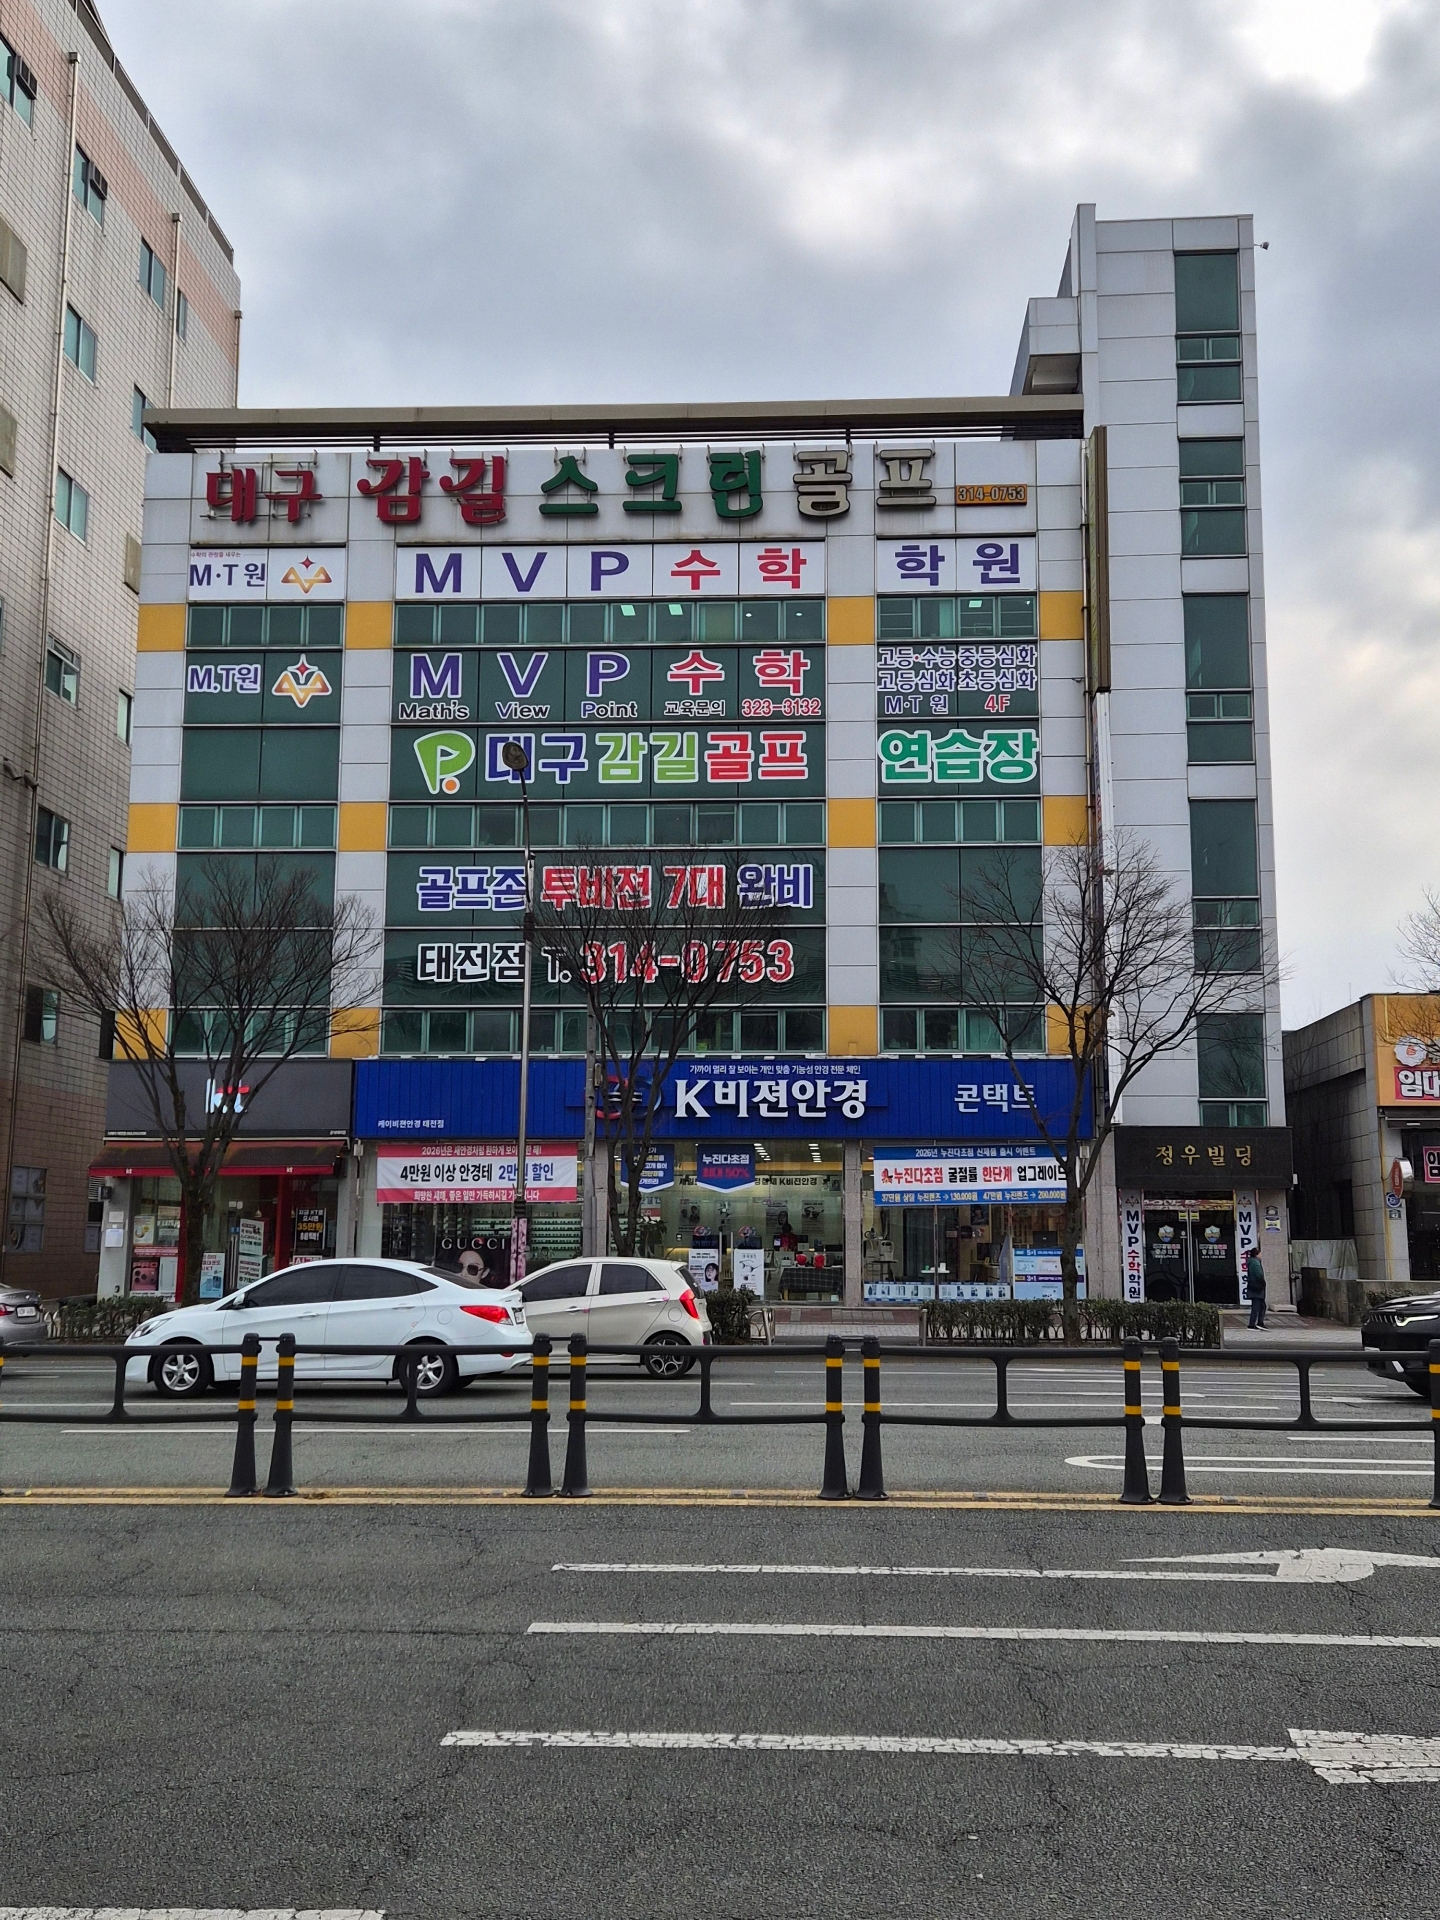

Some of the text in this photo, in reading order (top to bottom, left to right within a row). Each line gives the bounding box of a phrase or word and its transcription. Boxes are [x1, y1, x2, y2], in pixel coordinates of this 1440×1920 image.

[206, 448, 937, 525] 대구 감길 스크린 골프
[957, 486, 1026, 501] 314-0753
[958, 645, 1037, 668] 중등심화
[877, 668, 1037, 692] 고등심화 초등심화
[399, 700, 470, 720] Math's
[494, 701, 550, 719] View
[581, 700, 638, 719] Point
[664, 700, 726, 717] 교육문의
[741, 697, 821, 717] 323-3132
[985, 694, 1011, 713] 4F
[878, 729, 1040, 783] 연습장
[417, 866, 526, 911] 골프존
[663, 864, 726, 909] 7대
[737, 864, 813, 909] 완비
[417, 942, 525, 982] 태전점
[713, 1065, 727, 1074] 멀리
[728, 1065, 736, 1074] 잘
[737, 1065, 758, 1074] 보이는
[760, 1065, 774, 1074] 개인
[791, 1065, 813, 1074] 기능성
[814, 1065, 829, 1074] 안경
[830, 1065, 845, 1074] 전문
[846, 1065, 861, 1074] 체인
[205, 1078, 250, 1114] kt
[674, 1079, 868, 1119] K비젼안경
[954, 1083, 1037, 1113] 콘택트
[702, 1154, 750, 1164] 누진다초점
[1155, 1145, 1252, 1166] 정우빌딩
[400, 1164, 431, 1182] 4만원
[434, 1164, 456, 1182] 이상
[459, 1164, 493, 1182] 안경테
[532, 1163, 554, 1182] 할인
[894, 1167, 943, 1184] 누진다초점
[948, 1166, 978, 1183] 굴절률
[982, 1165, 1013, 1182] 한단계
[441, 1238, 506, 1250] GUCCI
